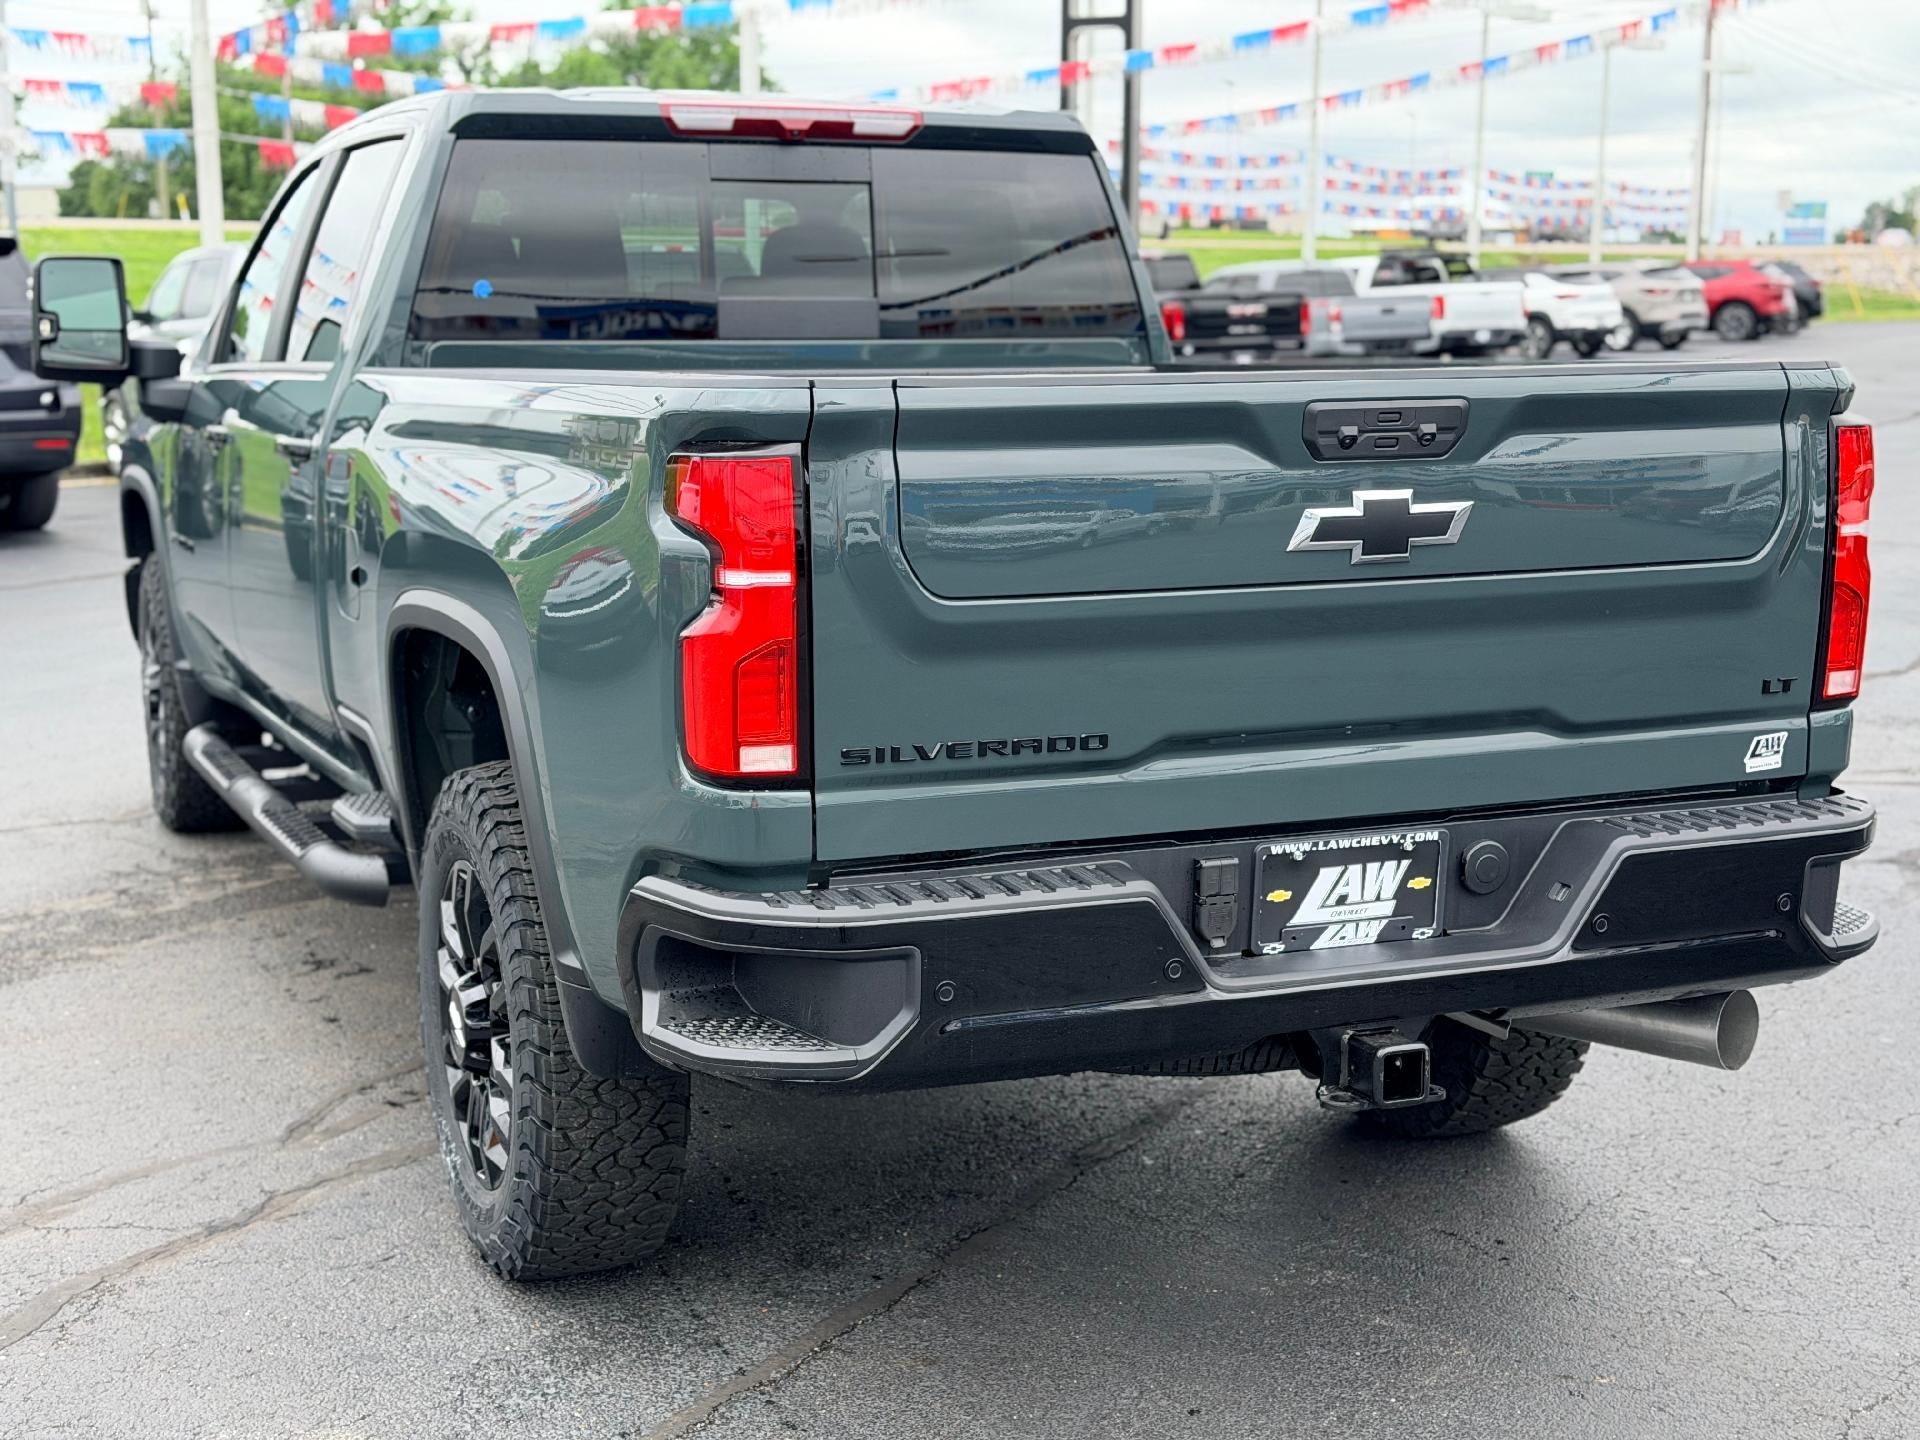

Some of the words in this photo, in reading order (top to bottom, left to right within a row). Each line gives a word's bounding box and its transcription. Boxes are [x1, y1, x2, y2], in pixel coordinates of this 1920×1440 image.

[1762, 678, 1798, 694] LT
[840, 732, 1109, 766] SILVERADO
[1749, 734, 1785, 759] LAW
[1270, 831, 1439, 855] WWW.LAWCHEVY.COM
[1286, 858, 1413, 926] LAW
[1310, 919, 1389, 950] LAW
